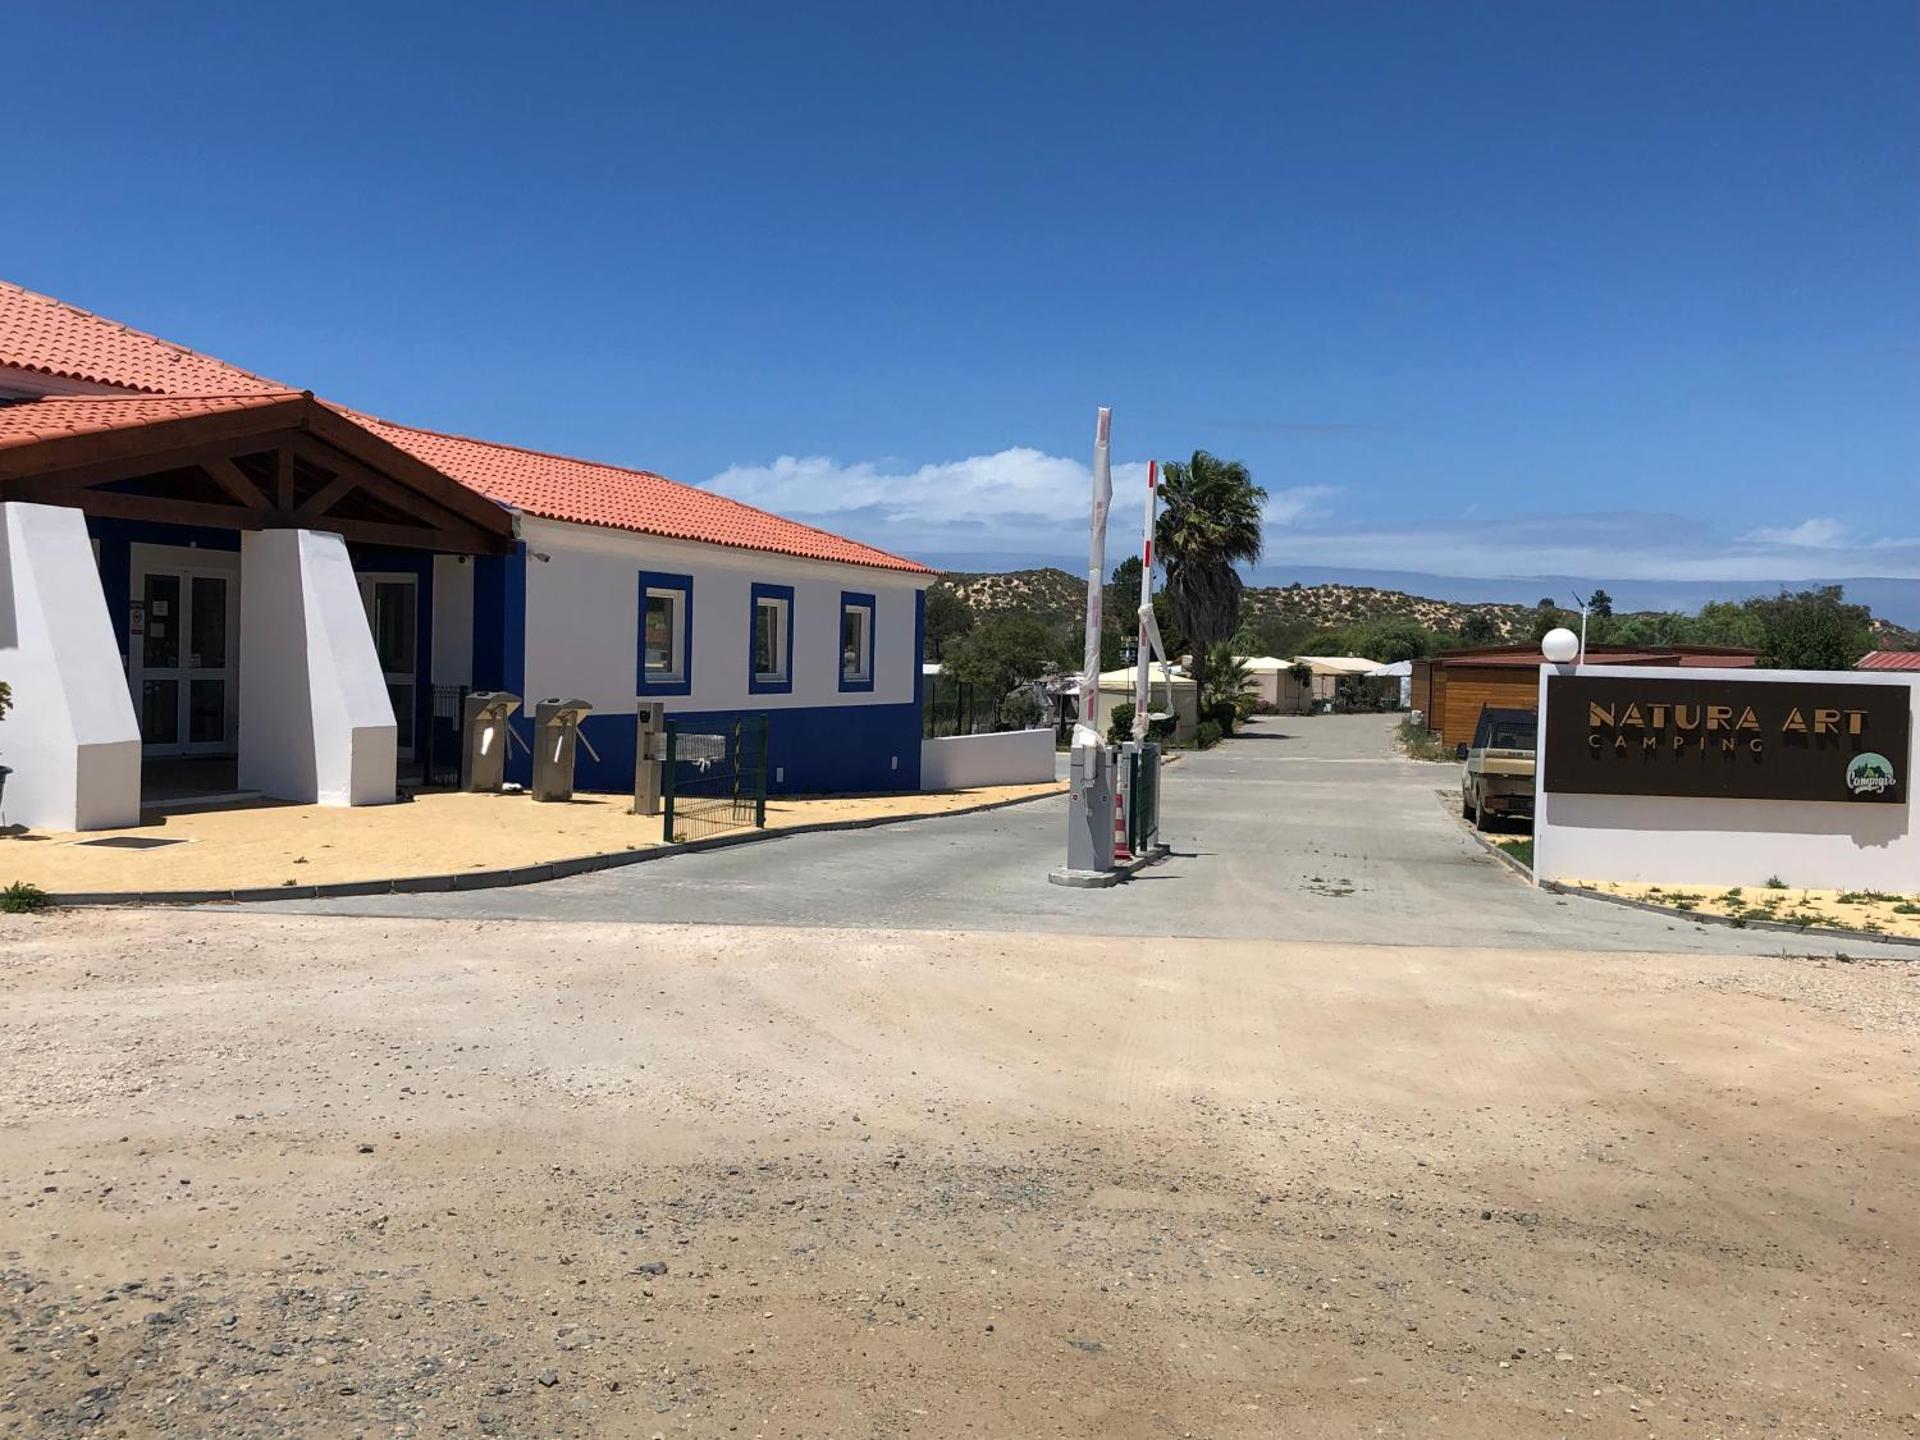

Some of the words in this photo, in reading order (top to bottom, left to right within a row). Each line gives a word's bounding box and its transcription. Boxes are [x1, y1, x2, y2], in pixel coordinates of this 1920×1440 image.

[1589, 701, 1761, 731] NATURA
[1782, 707, 1869, 734] ART
[1588, 734, 1763, 752] CAMPING
